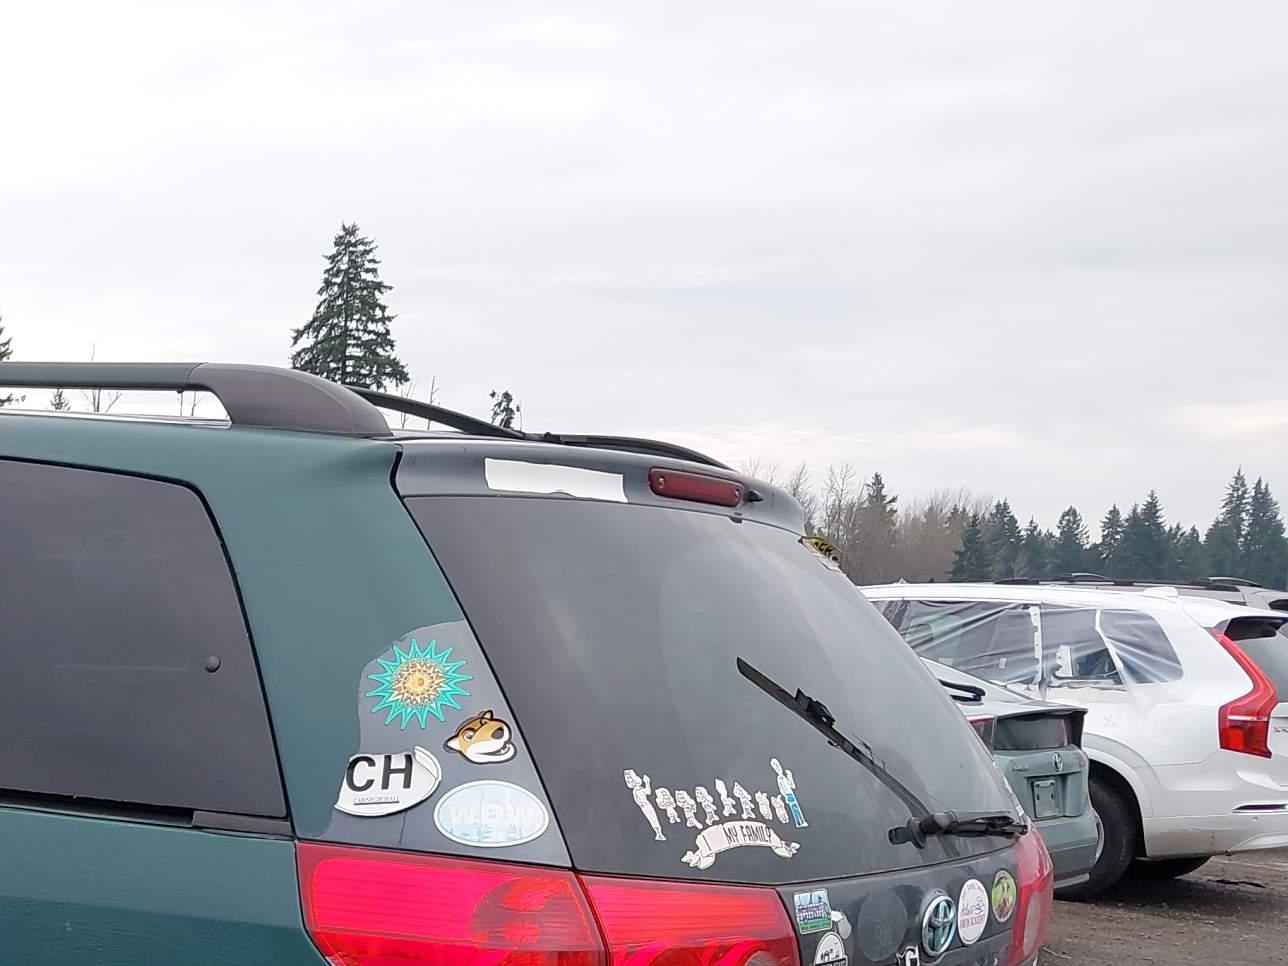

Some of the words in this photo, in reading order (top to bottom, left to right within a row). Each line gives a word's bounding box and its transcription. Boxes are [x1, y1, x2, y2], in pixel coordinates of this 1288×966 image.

[346, 754, 413, 792] CH
[448, 803, 536, 826] WDW
[723, 826, 739, 845] MY
[742, 826, 773, 844] FAMILY
